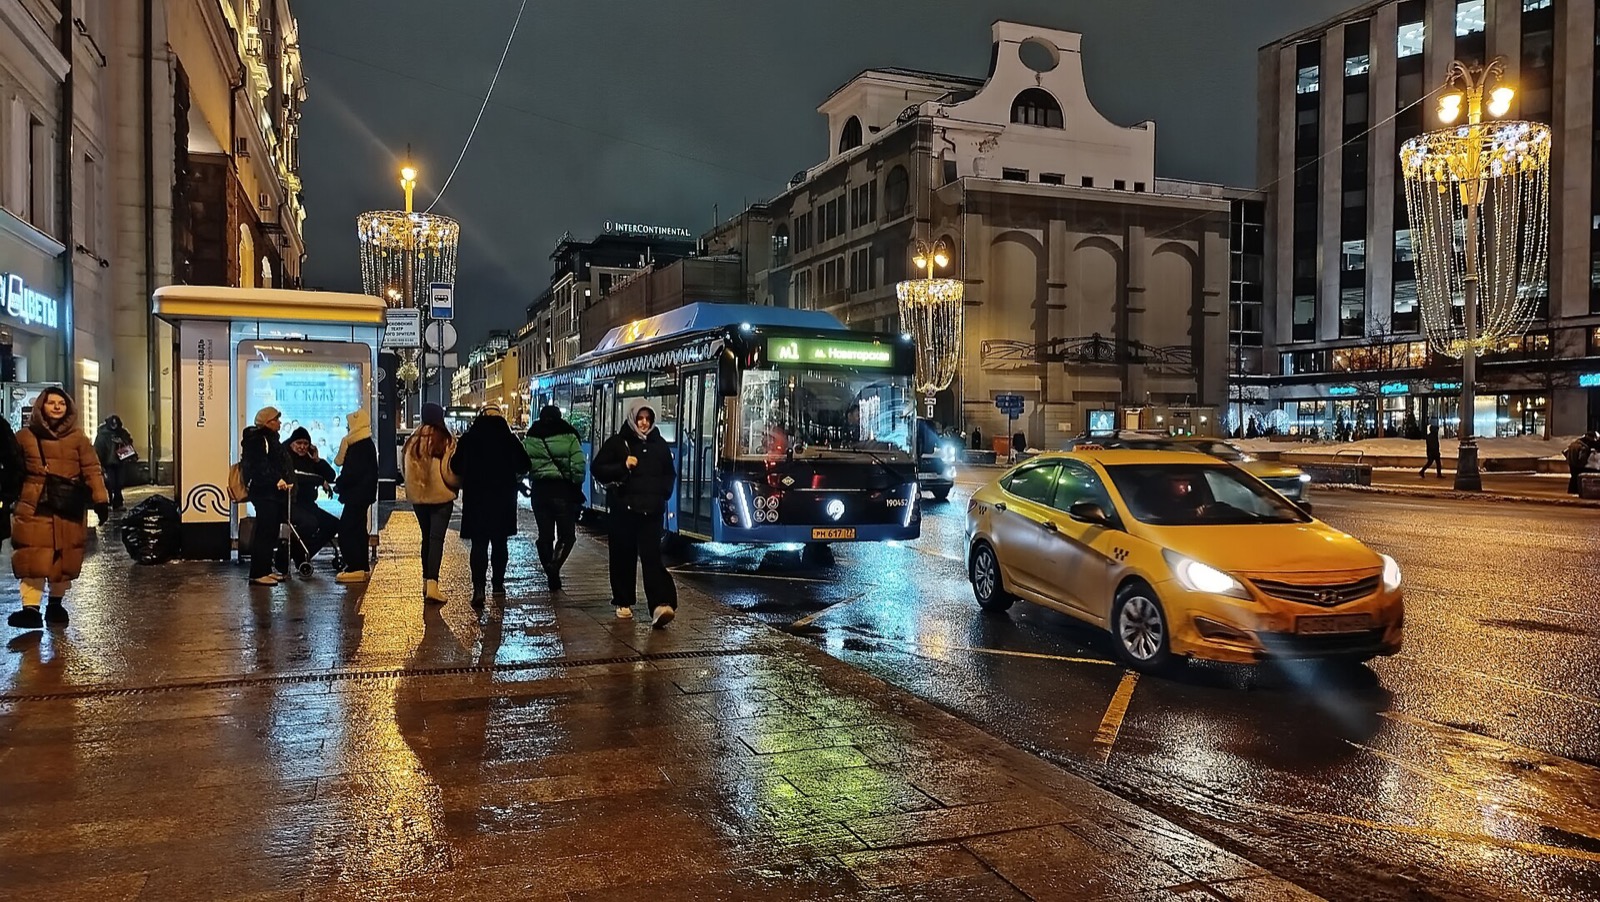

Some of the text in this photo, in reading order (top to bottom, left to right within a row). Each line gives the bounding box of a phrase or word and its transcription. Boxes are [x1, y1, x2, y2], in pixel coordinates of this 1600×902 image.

[21, 287, 58, 329] ЦВЕТЫ
[196, 339, 207, 428] Пушкинская площадь
[293, 388, 337, 402] СКАЖУ
[886, 499, 908, 508] 190452
[828, 530, 842, 538] 617
